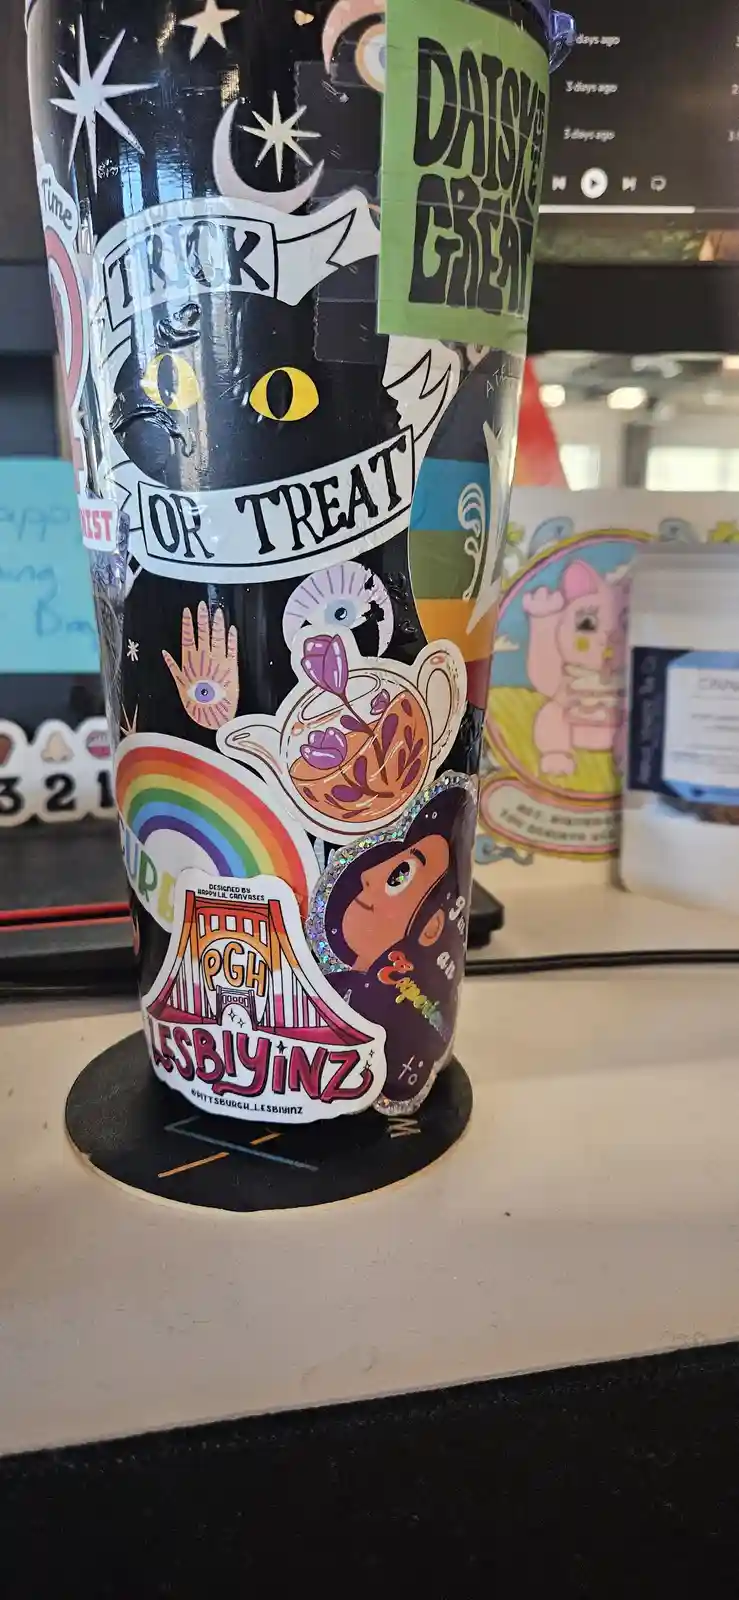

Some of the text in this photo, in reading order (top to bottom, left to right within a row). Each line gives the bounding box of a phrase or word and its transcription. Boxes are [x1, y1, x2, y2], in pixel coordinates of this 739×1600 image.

[576, 33, 599, 46] days
[600, 36, 620, 47] ago
[574, 81, 597, 94] days
[598, 84, 618, 95] ago
[413, 37, 539, 207] DAISY
[571, 128, 595, 142] days
[595, 130, 615, 142] ago
[108, 220, 271, 308] TRICK
[408, 174, 535, 319] GREAT
[149, 434, 407, 559] OR TREAT
[0, 769, 115, 816] 3 2 1
[198, 888, 265, 901] HAPPY LIL CANVASES
[208, 883, 240, 893] DESIGNED
[203, 941, 268, 998] PGH
